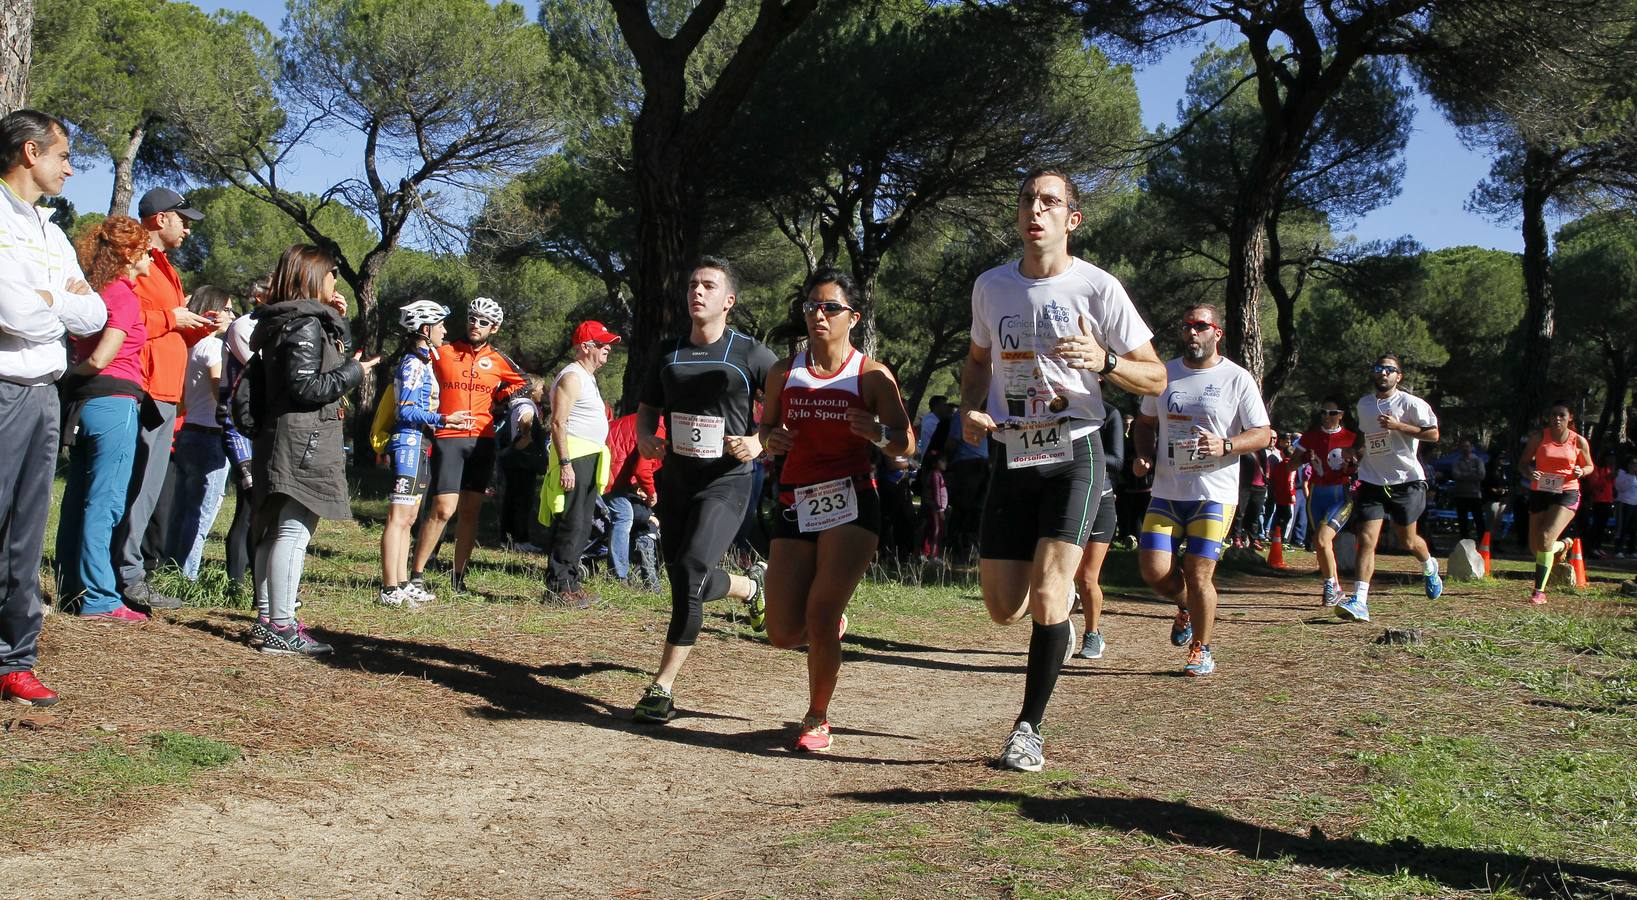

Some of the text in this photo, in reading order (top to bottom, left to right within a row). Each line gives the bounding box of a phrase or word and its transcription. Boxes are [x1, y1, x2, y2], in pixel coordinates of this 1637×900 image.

[1043, 313, 1070, 323] DUERO
[789, 397, 849, 408] VALLADOLID
[787, 408, 811, 421] Eylo
[690, 428, 702, 443] 3
[1019, 428, 1060, 449] 144
[1370, 438, 1386, 449] 261
[1013, 451, 1066, 463] dorsalia.com
[1545, 478, 1556, 488] 91
[808, 493, 848, 517] 233
